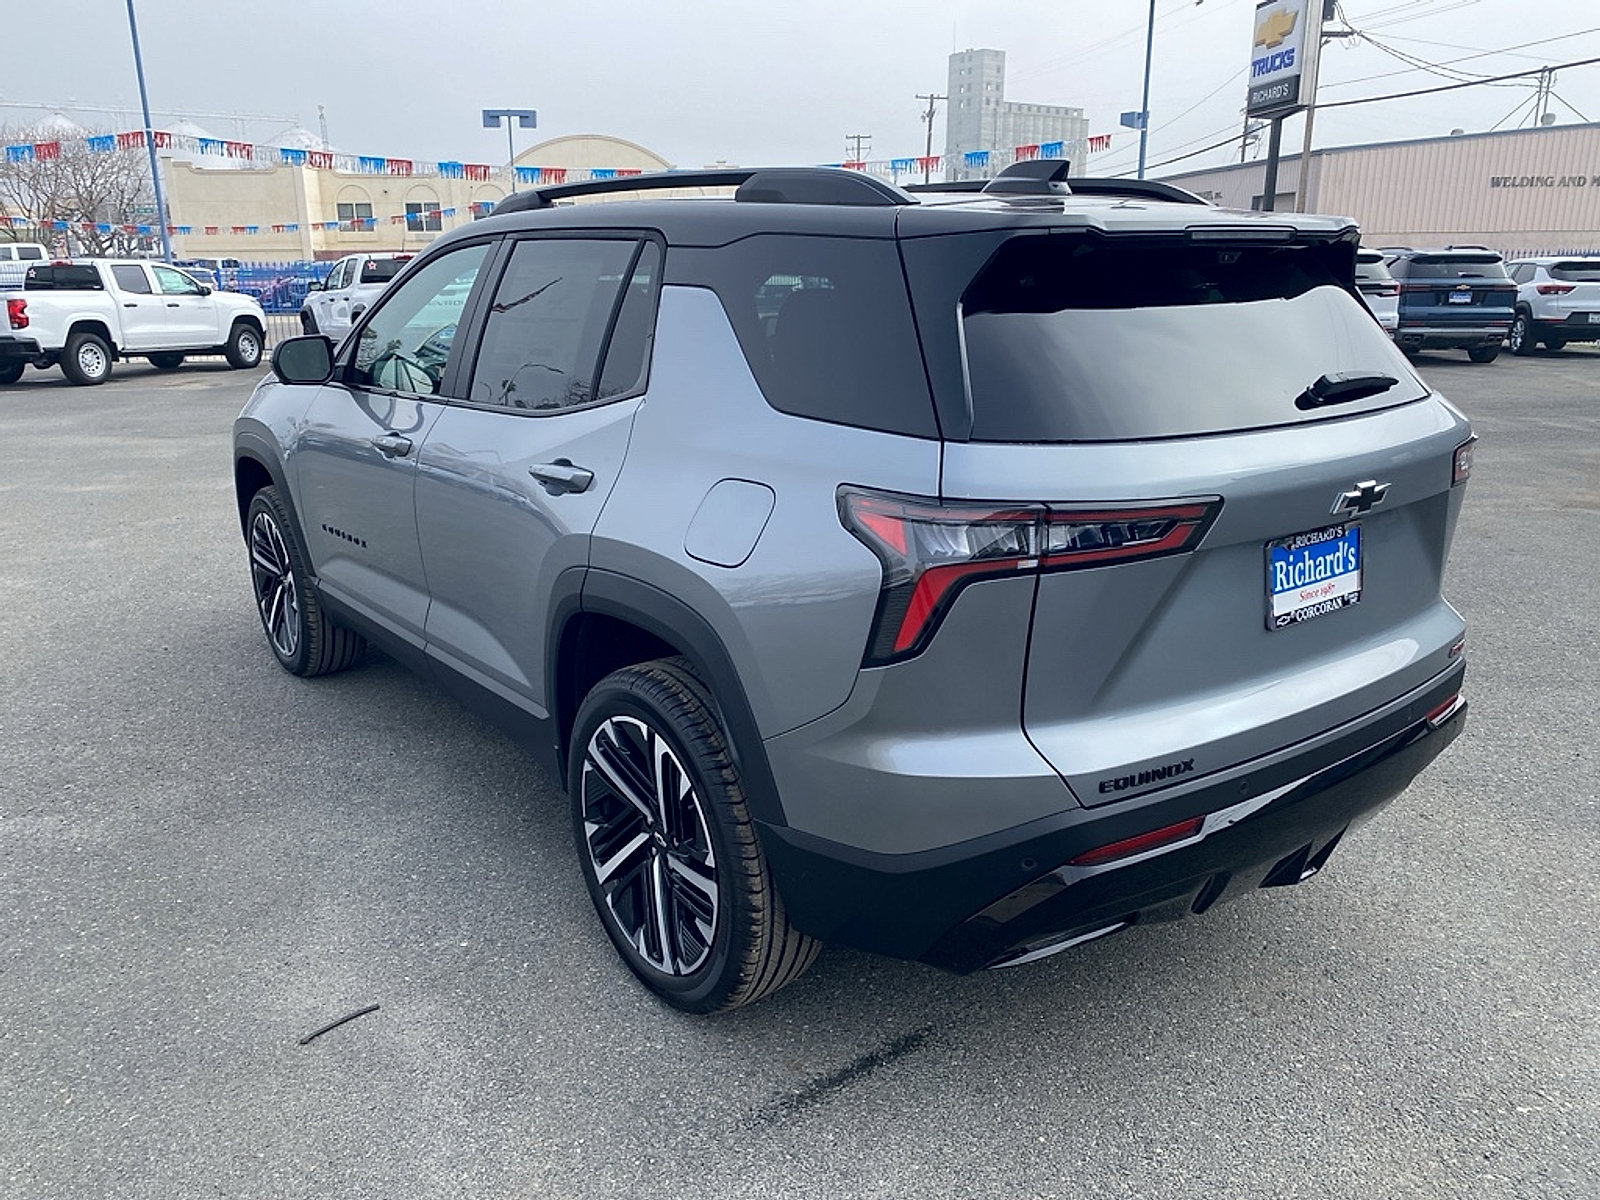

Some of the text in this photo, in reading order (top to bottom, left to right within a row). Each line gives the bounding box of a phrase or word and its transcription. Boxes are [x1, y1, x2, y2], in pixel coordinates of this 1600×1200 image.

[1251, 47, 1295, 77] TRUCKS
[1252, 82, 1289, 104] RICHARD'S
[1490, 176, 1555, 188] WELDING
[1558, 176, 1587, 187] AND
[1295, 526, 1344, 548] RICHARD'S
[1274, 541, 1356, 592] Richard's
[1299, 589, 1320, 602] Since
[1296, 598, 1343, 621] CORCORAN
[1098, 758, 1194, 793] EQUINOX
